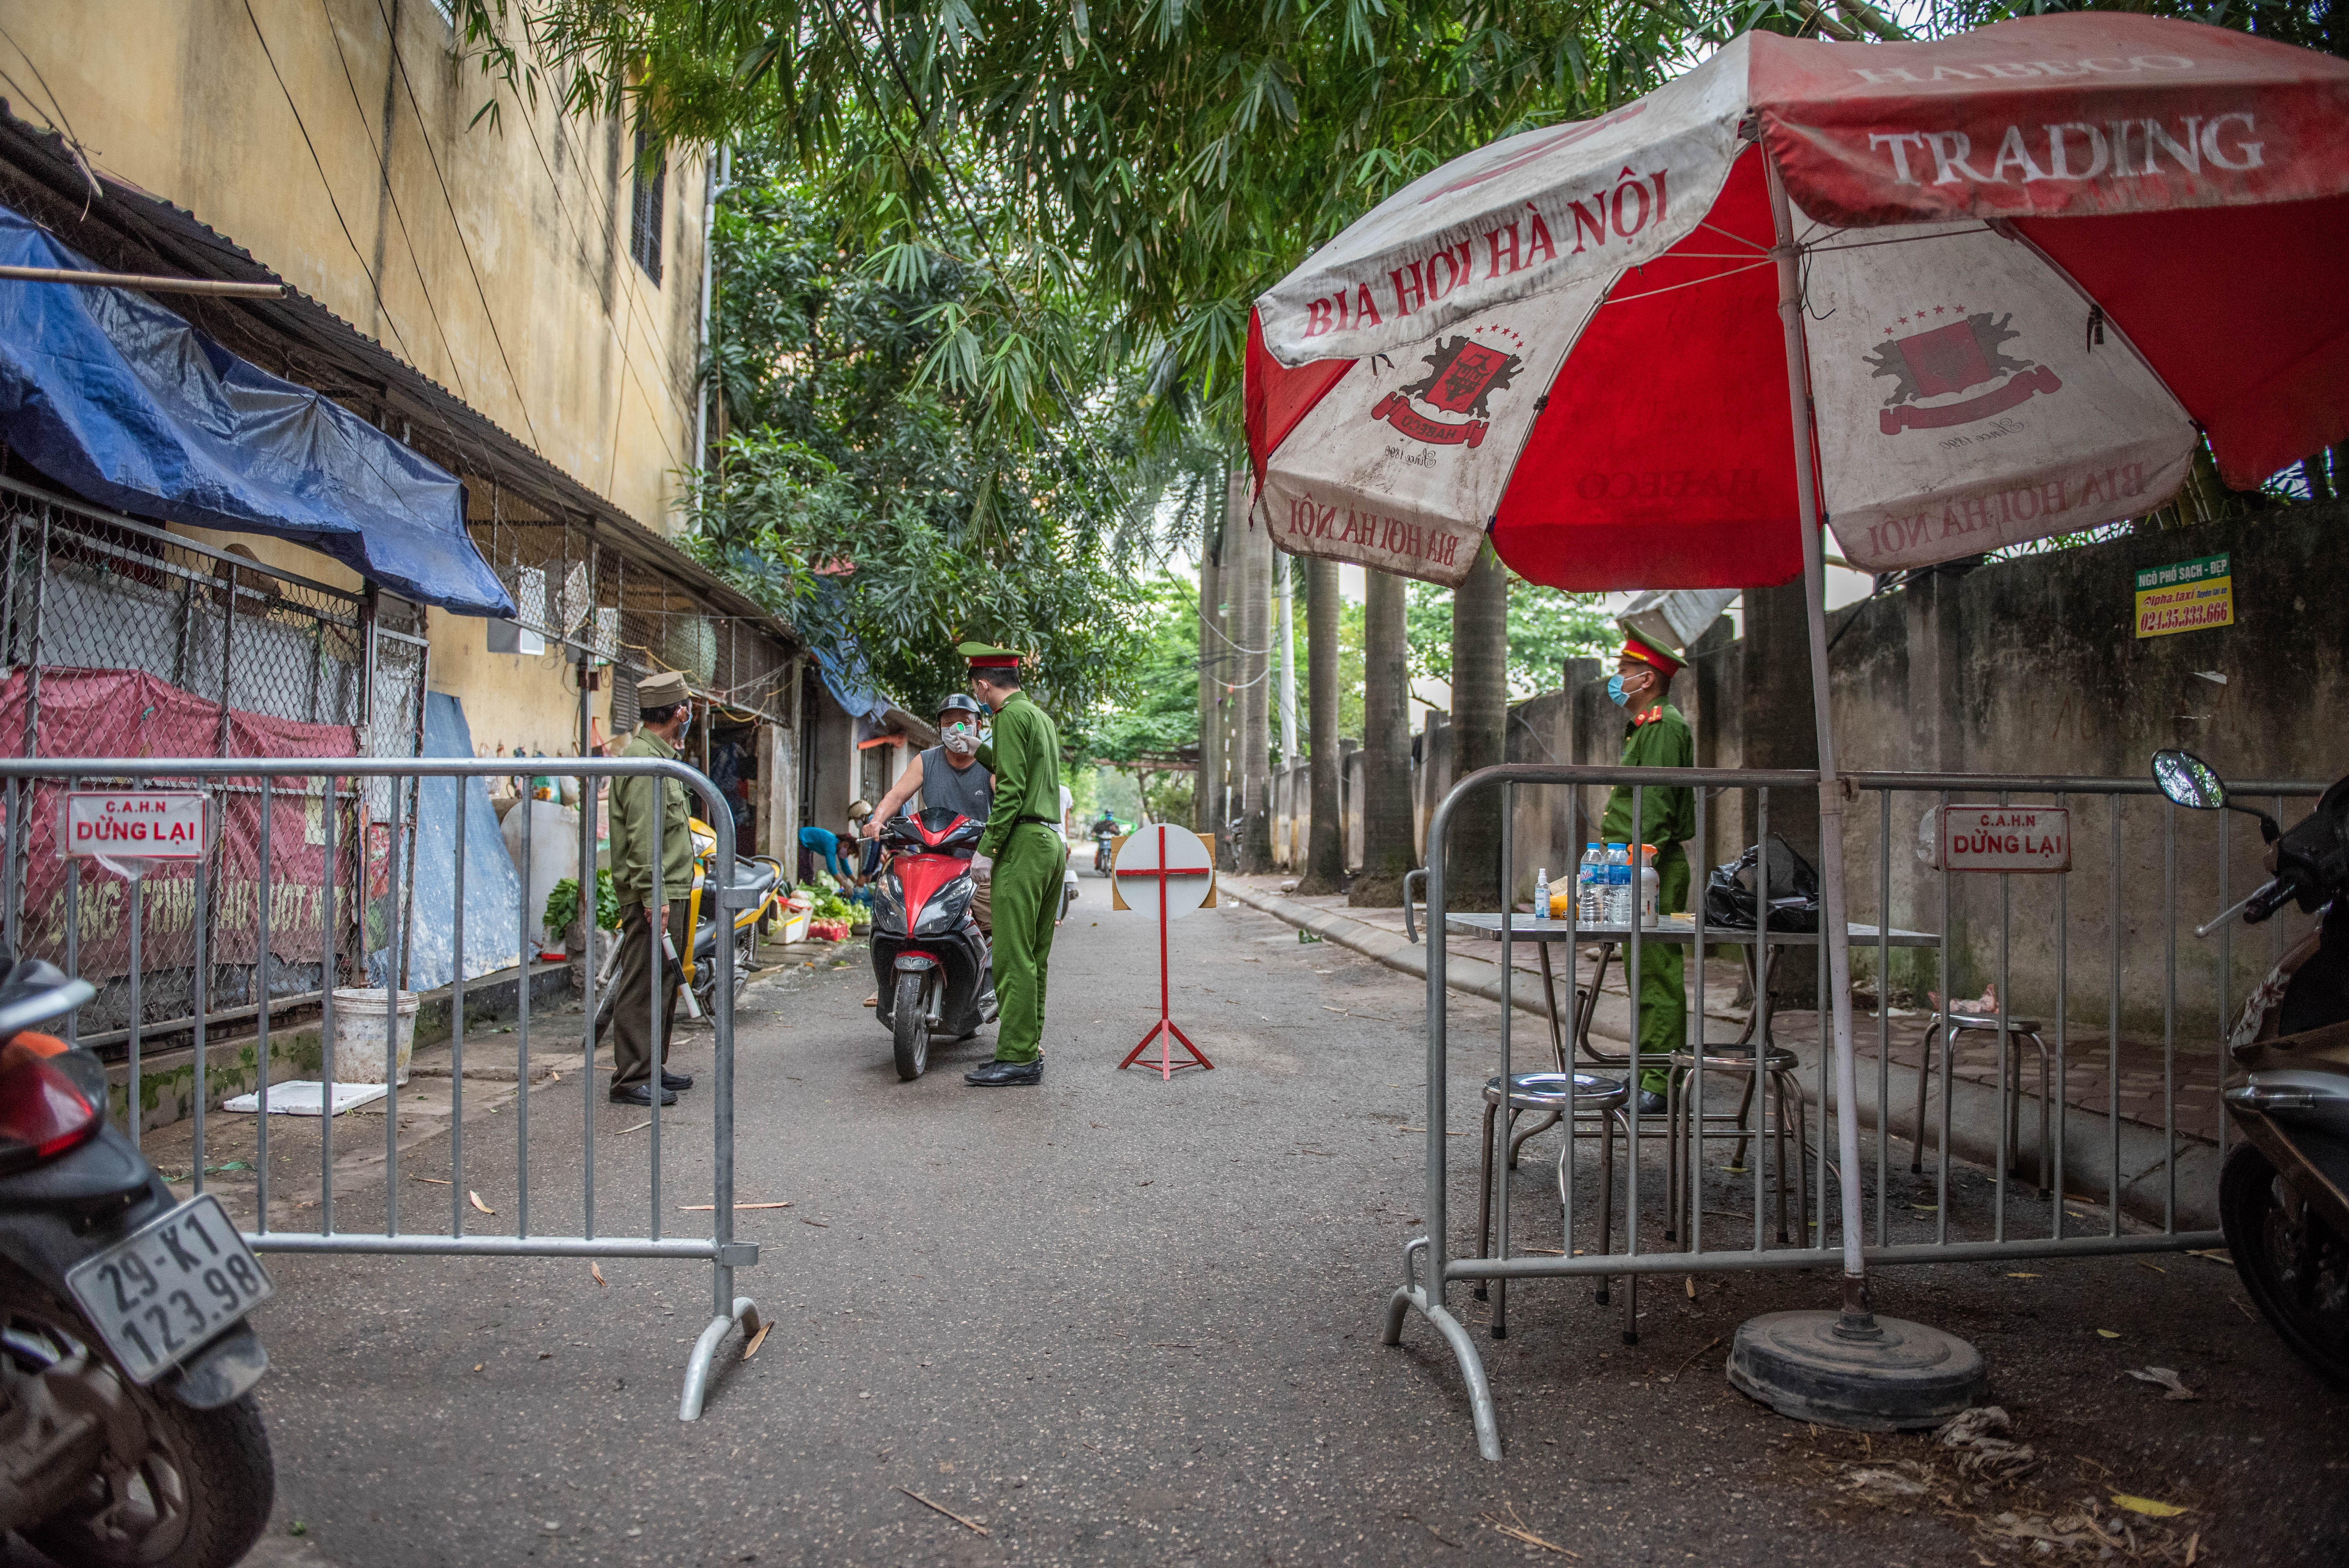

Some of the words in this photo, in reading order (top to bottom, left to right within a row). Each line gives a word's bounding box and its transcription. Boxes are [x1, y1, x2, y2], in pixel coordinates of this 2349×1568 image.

[1852, 55, 2194, 84] HABECO
[1869, 113, 2265, 186] TRADING
[1302, 283, 1383, 339] BIA
[1388, 240, 1471, 318] HƠI
[1484, 202, 1556, 278] HÀ
[1567, 166, 1668, 254] NỘI
[2159, 565, 2177, 583] PHỐ
[2179, 564, 2203, 582] SẠCH
[2210, 559, 2227, 576] ĐẸP
[2140, 600, 2227, 632] 024.35.333.666
[106, 800, 166, 813] C.A.H.N
[1980, 814, 2035, 827] C.A.H.N
[77, 814, 147, 840] DỪNG
[153, 821, 194, 845] LẠI
[1954, 829, 2019, 853] DỪNG
[2026, 836, 2061, 858] LẠI
[96, 1212, 222, 1314] 29-K1
[118, 1253, 262, 1367] 123.98
